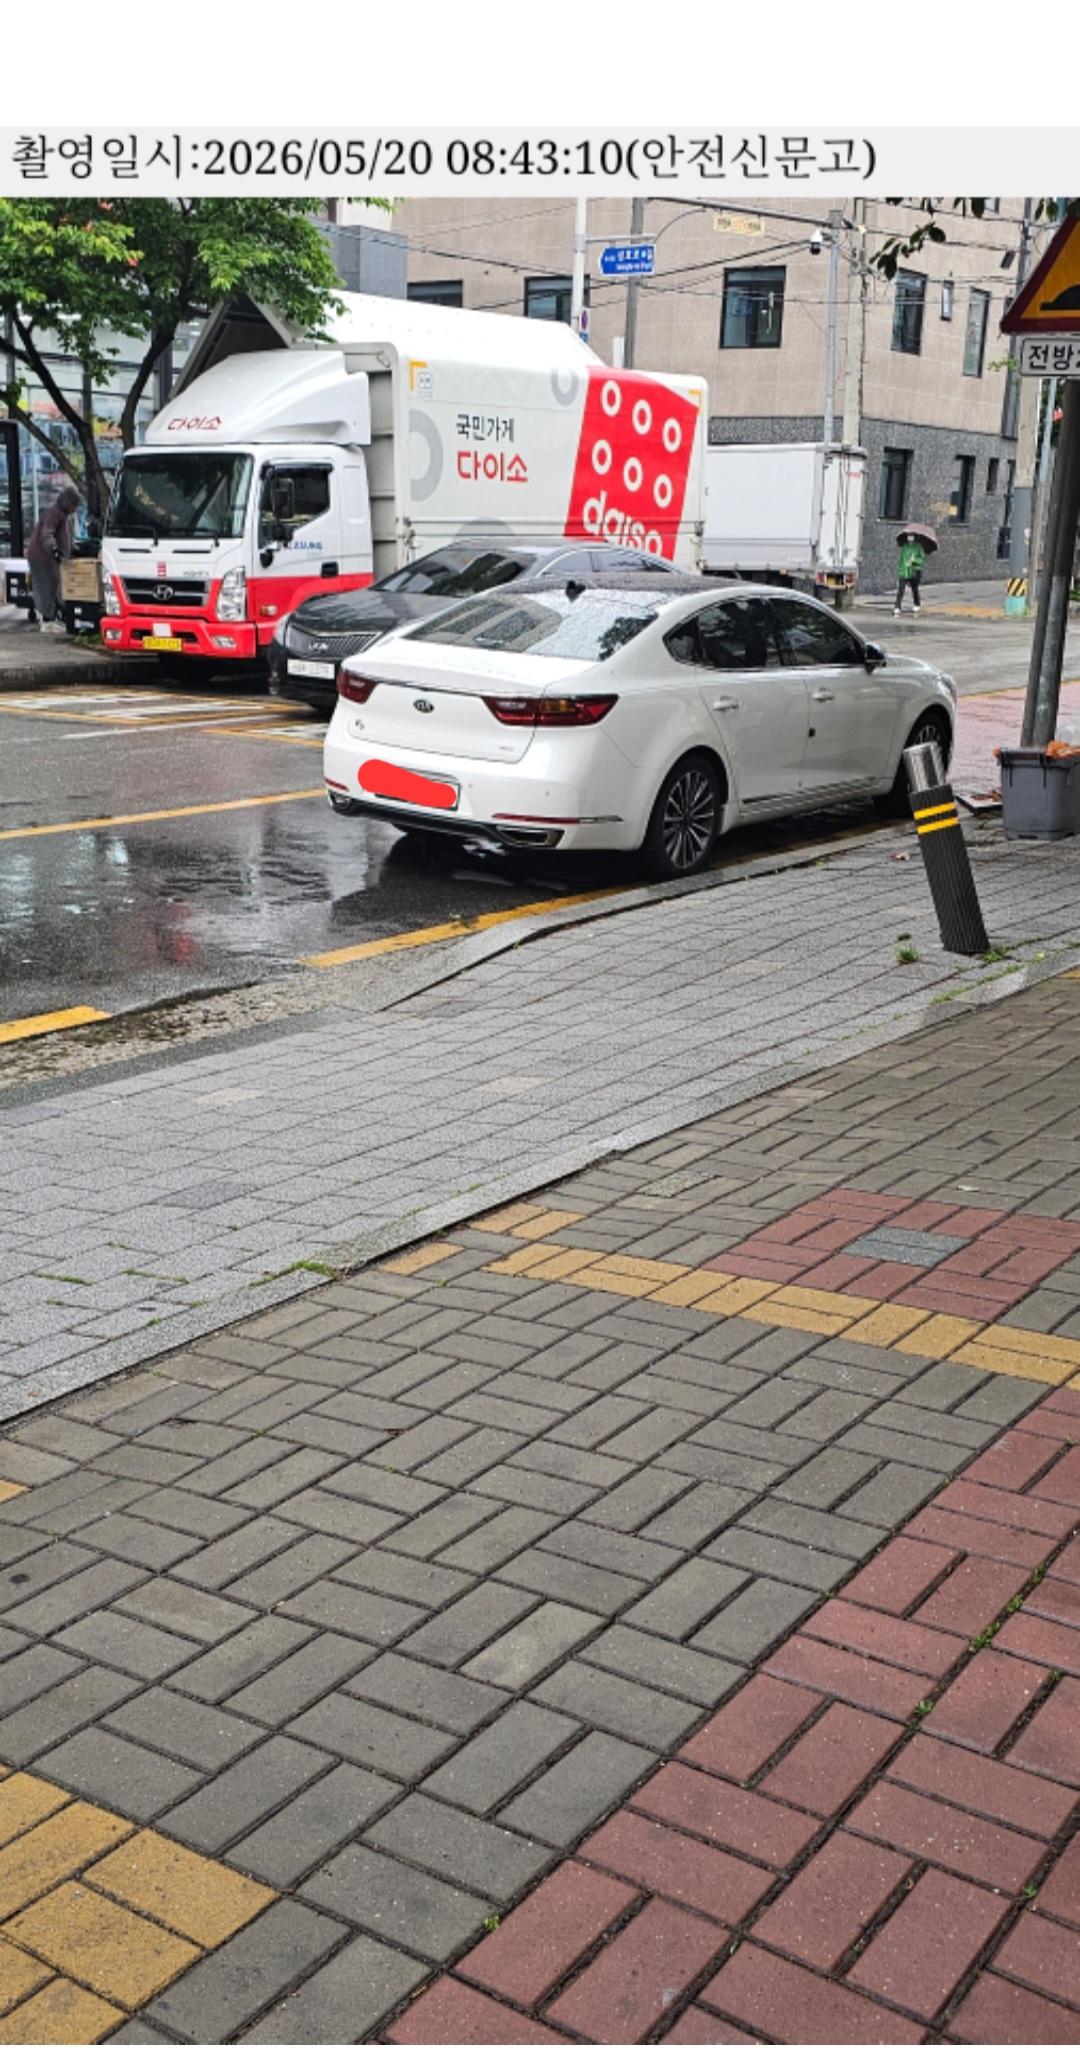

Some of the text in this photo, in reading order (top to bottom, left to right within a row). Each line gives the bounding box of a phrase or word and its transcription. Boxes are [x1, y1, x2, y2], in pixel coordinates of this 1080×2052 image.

[1028, 343, 1080, 370] 전방
[167, 415, 222, 431] 다이소
[456, 413, 514, 443] 국민가게
[457, 450, 529, 482] 다이소
